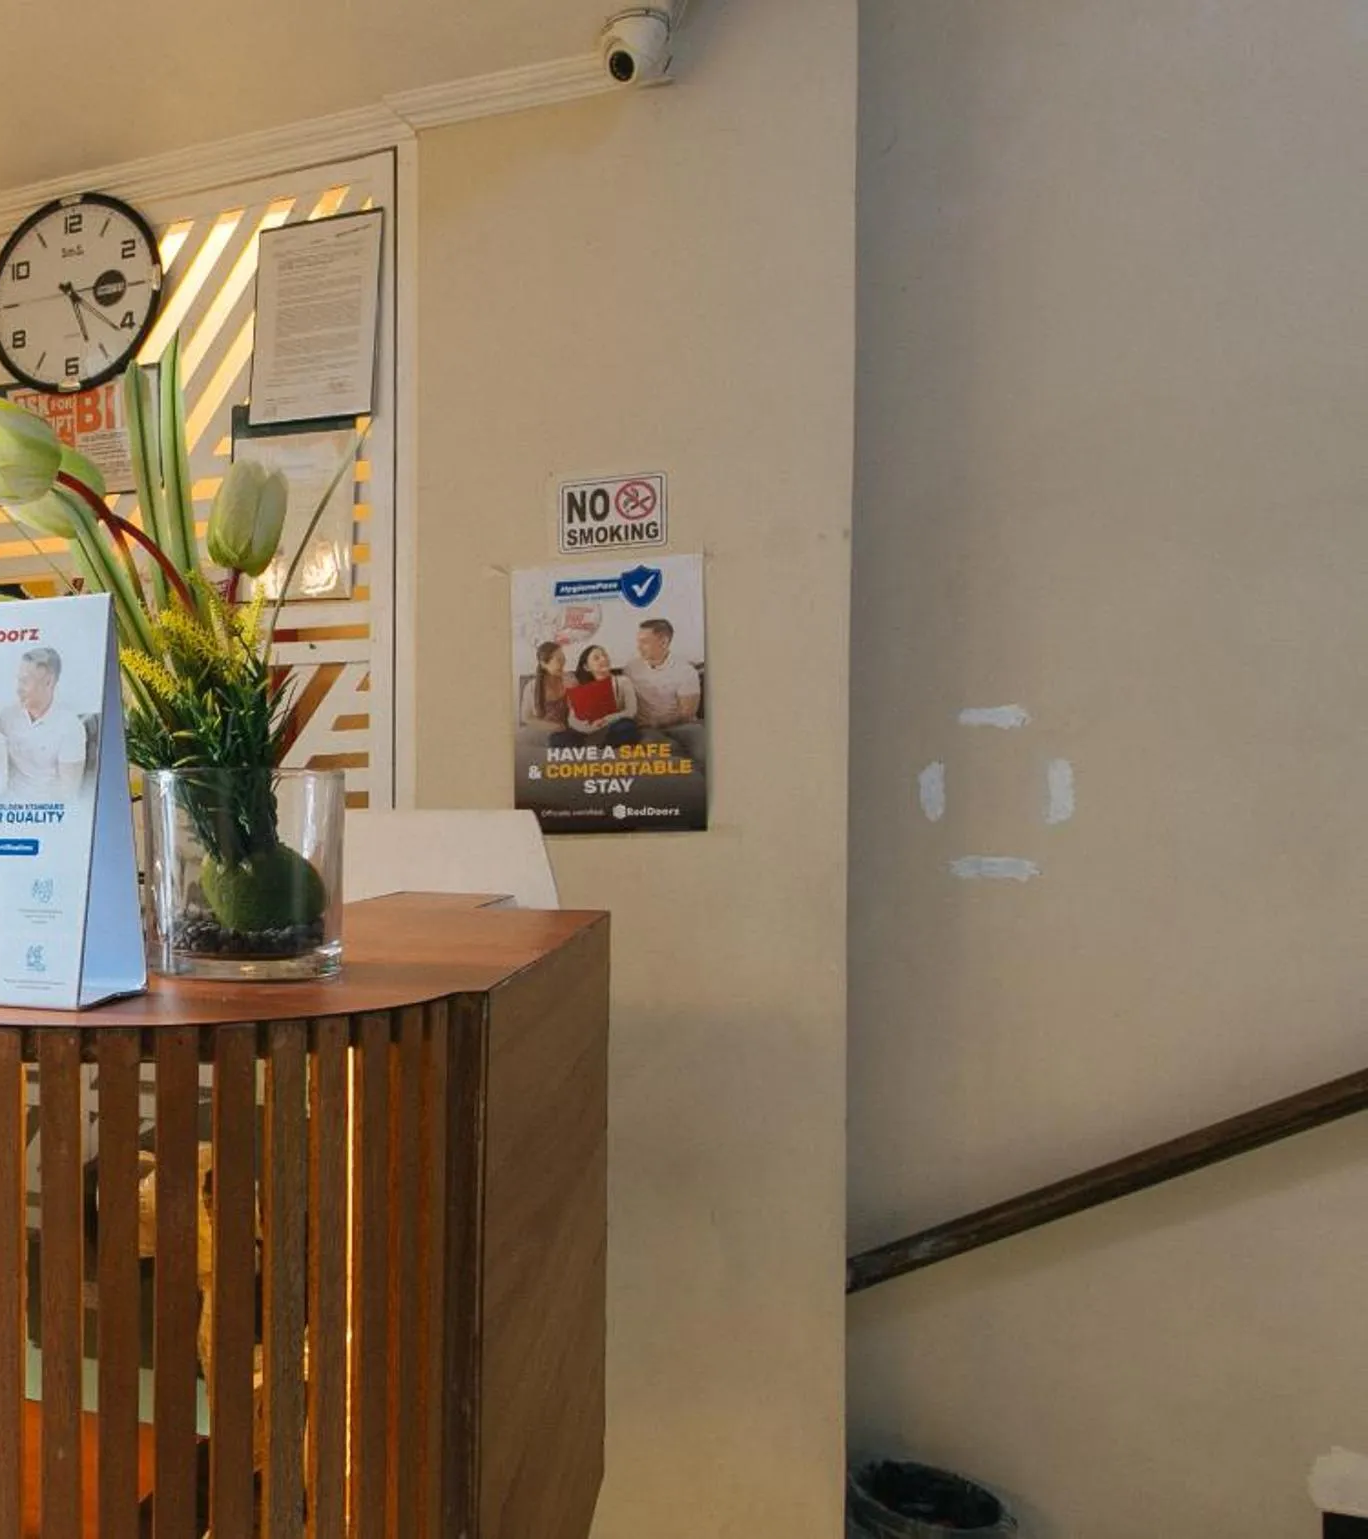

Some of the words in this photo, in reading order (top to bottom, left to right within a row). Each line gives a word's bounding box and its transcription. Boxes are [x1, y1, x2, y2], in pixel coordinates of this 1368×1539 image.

[63, 214, 83, 235] 12
[121, 238, 137, 260] 2
[11, 260, 31, 281] 10
[119, 310, 137, 331] 4
[11, 329, 27, 350] 8
[64, 356, 80, 376] 6
[566, 487, 611, 525] NO
[566, 520, 660, 547] SMOKING
[546, 745, 597, 762] HAVE
[601, 745, 616, 760] A
[619, 742, 672, 760] SAFE
[528, 764, 542, 780] &
[545, 758, 693, 779] COMFORTABLE
[583, 778, 634, 794] STAY
[6, 811, 65, 824] QUALITY
